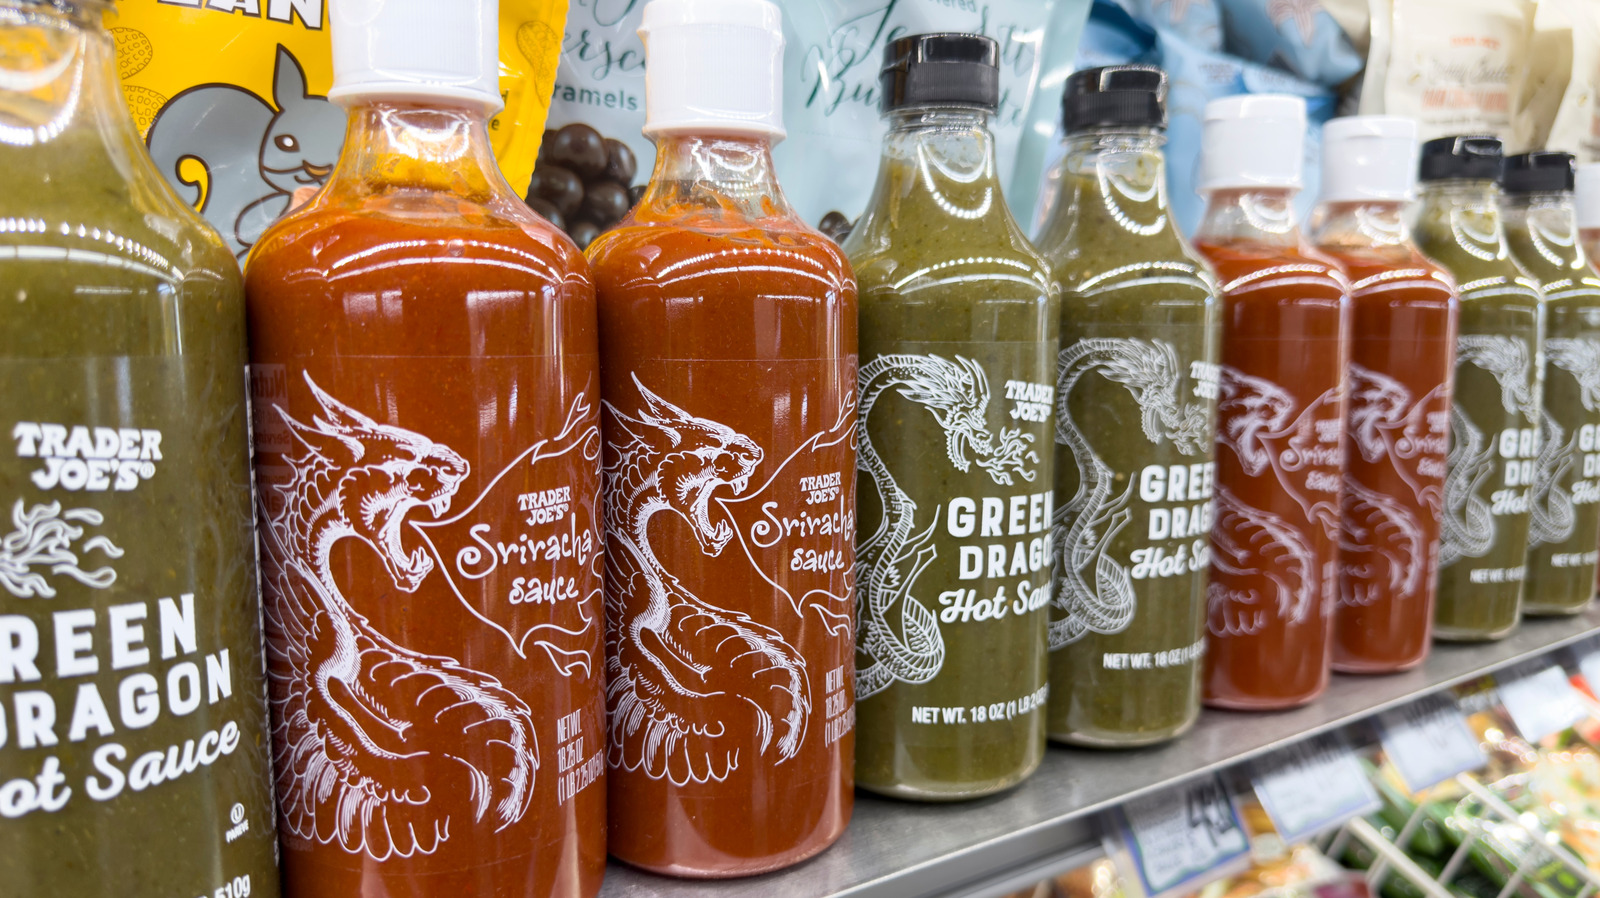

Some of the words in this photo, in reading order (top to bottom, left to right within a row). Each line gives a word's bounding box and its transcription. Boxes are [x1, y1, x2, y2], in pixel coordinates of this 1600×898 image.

[552, 83, 638, 111] ramels
[13, 422, 162, 461] TRADER
[518, 485, 572, 512] TRADER
[799, 471, 841, 492] TRADER
[1139, 461, 1215, 503] GREE
[751, 494, 854, 549] Sriracha
[1148, 501, 1213, 541] DRAG
[456, 512, 592, 580] Sriracha
[790, 547, 846, 574] sauce
[959, 532, 1053, 580] DRAGO
[1129, 544, 1187, 579] Hot
[509, 576, 579, 605] sauce
[938, 586, 1008, 624] Hot
[1013, 580, 1053, 616] Sau
[0, 593, 198, 683] REEN
[1103, 652, 1129, 670] NET
[0, 648, 232, 750] RAGON
[912, 705, 940, 725] NET
[942, 706, 967, 725] WT.
[970, 704, 987, 724] 18
[988, 702, 1005, 721] OZ
[0, 756, 72, 818] ot
[85, 720, 241, 801] Sauce
